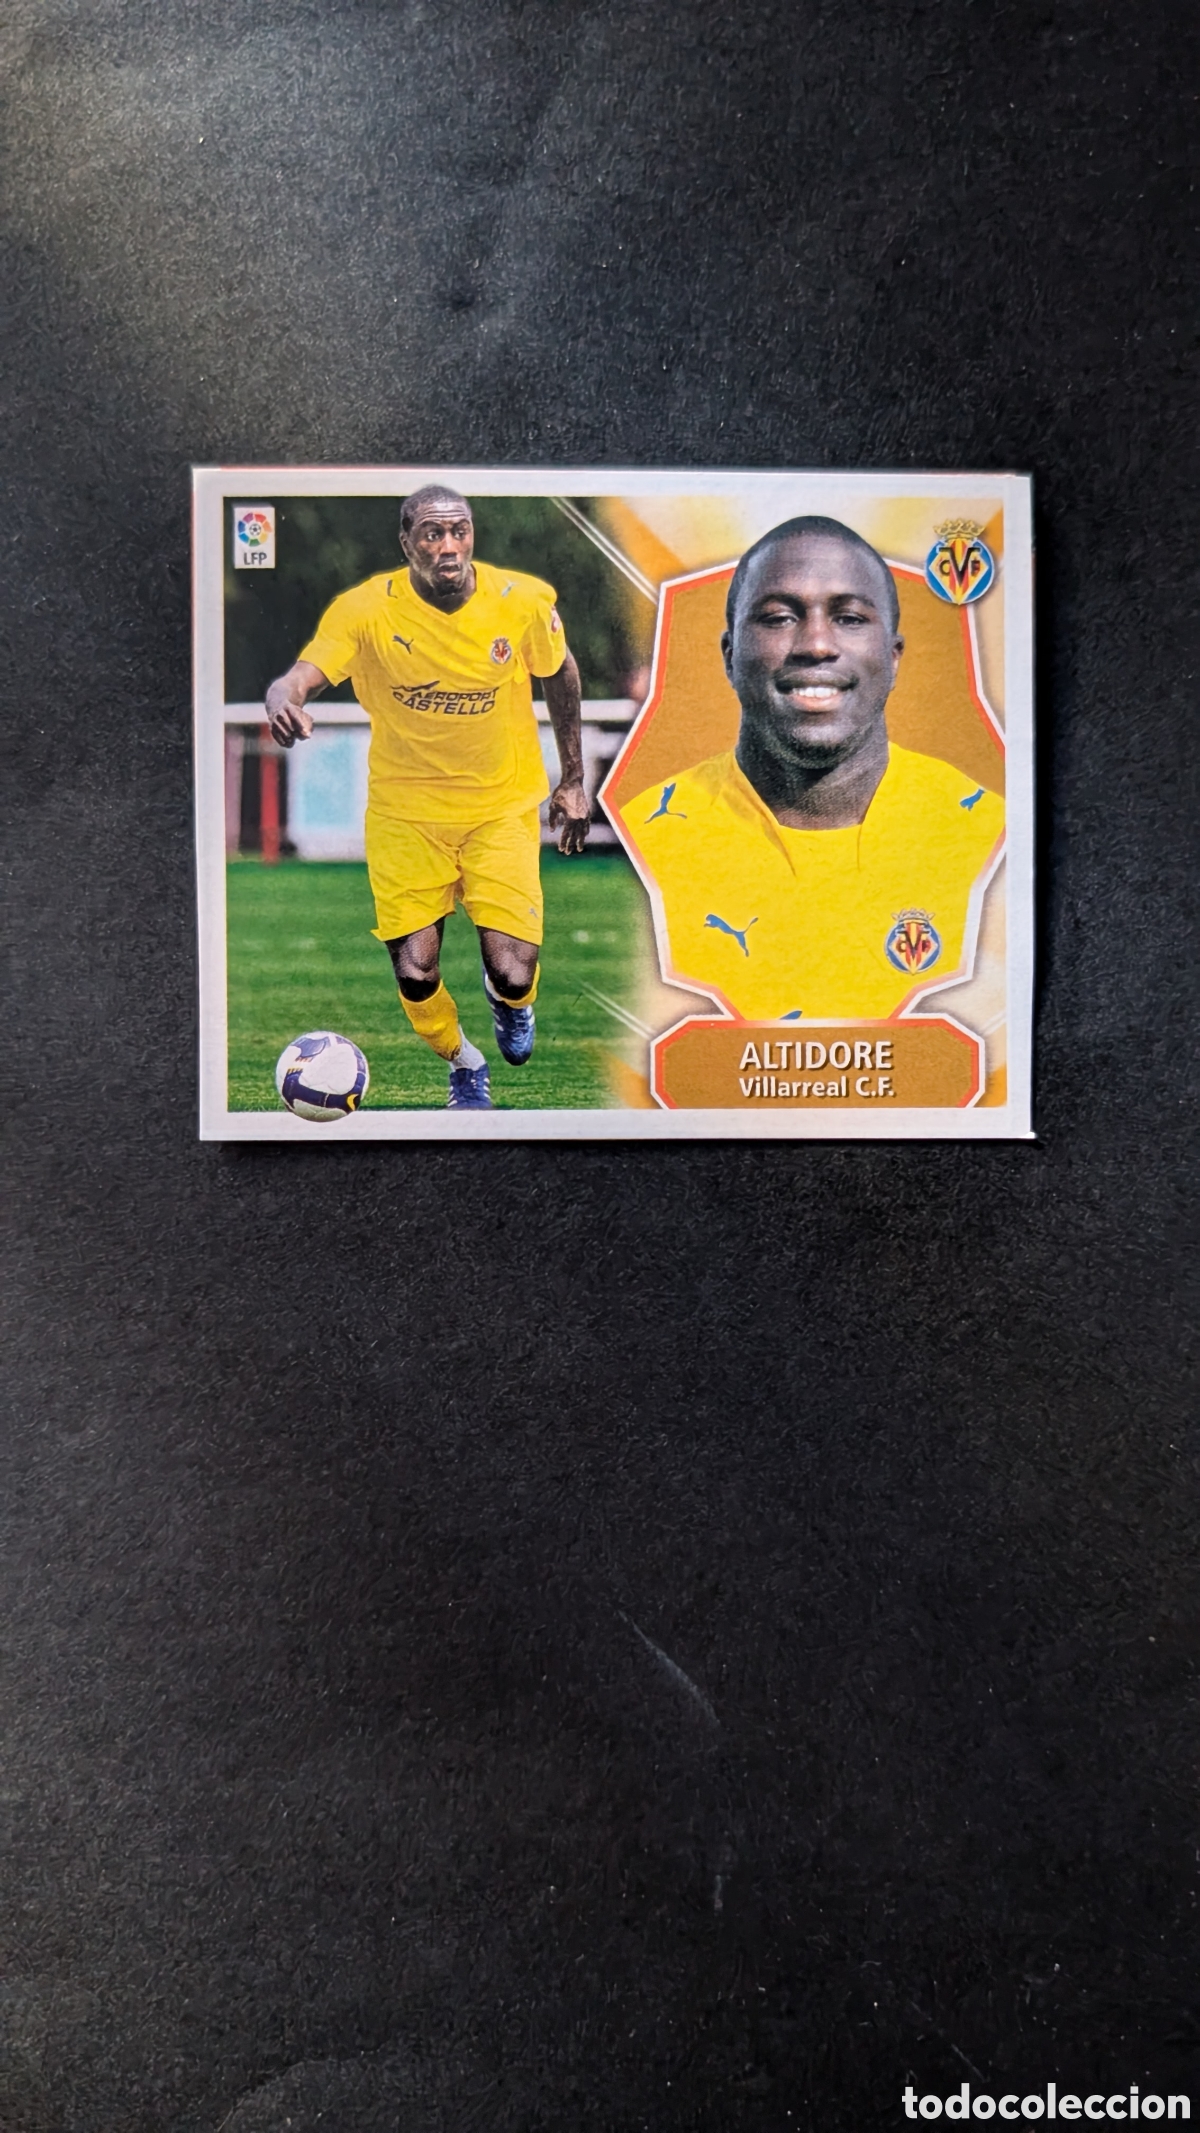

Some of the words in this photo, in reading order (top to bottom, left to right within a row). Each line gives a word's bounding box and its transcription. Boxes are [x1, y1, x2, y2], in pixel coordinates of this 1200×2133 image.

[243, 551, 268, 566] LFP
[411, 687, 500, 702] AEROPORT
[739, 1041, 893, 1070] ALTIDORE
[739, 1075, 848, 1098] Villarreal
[855, 1076, 895, 1098] C.F.
